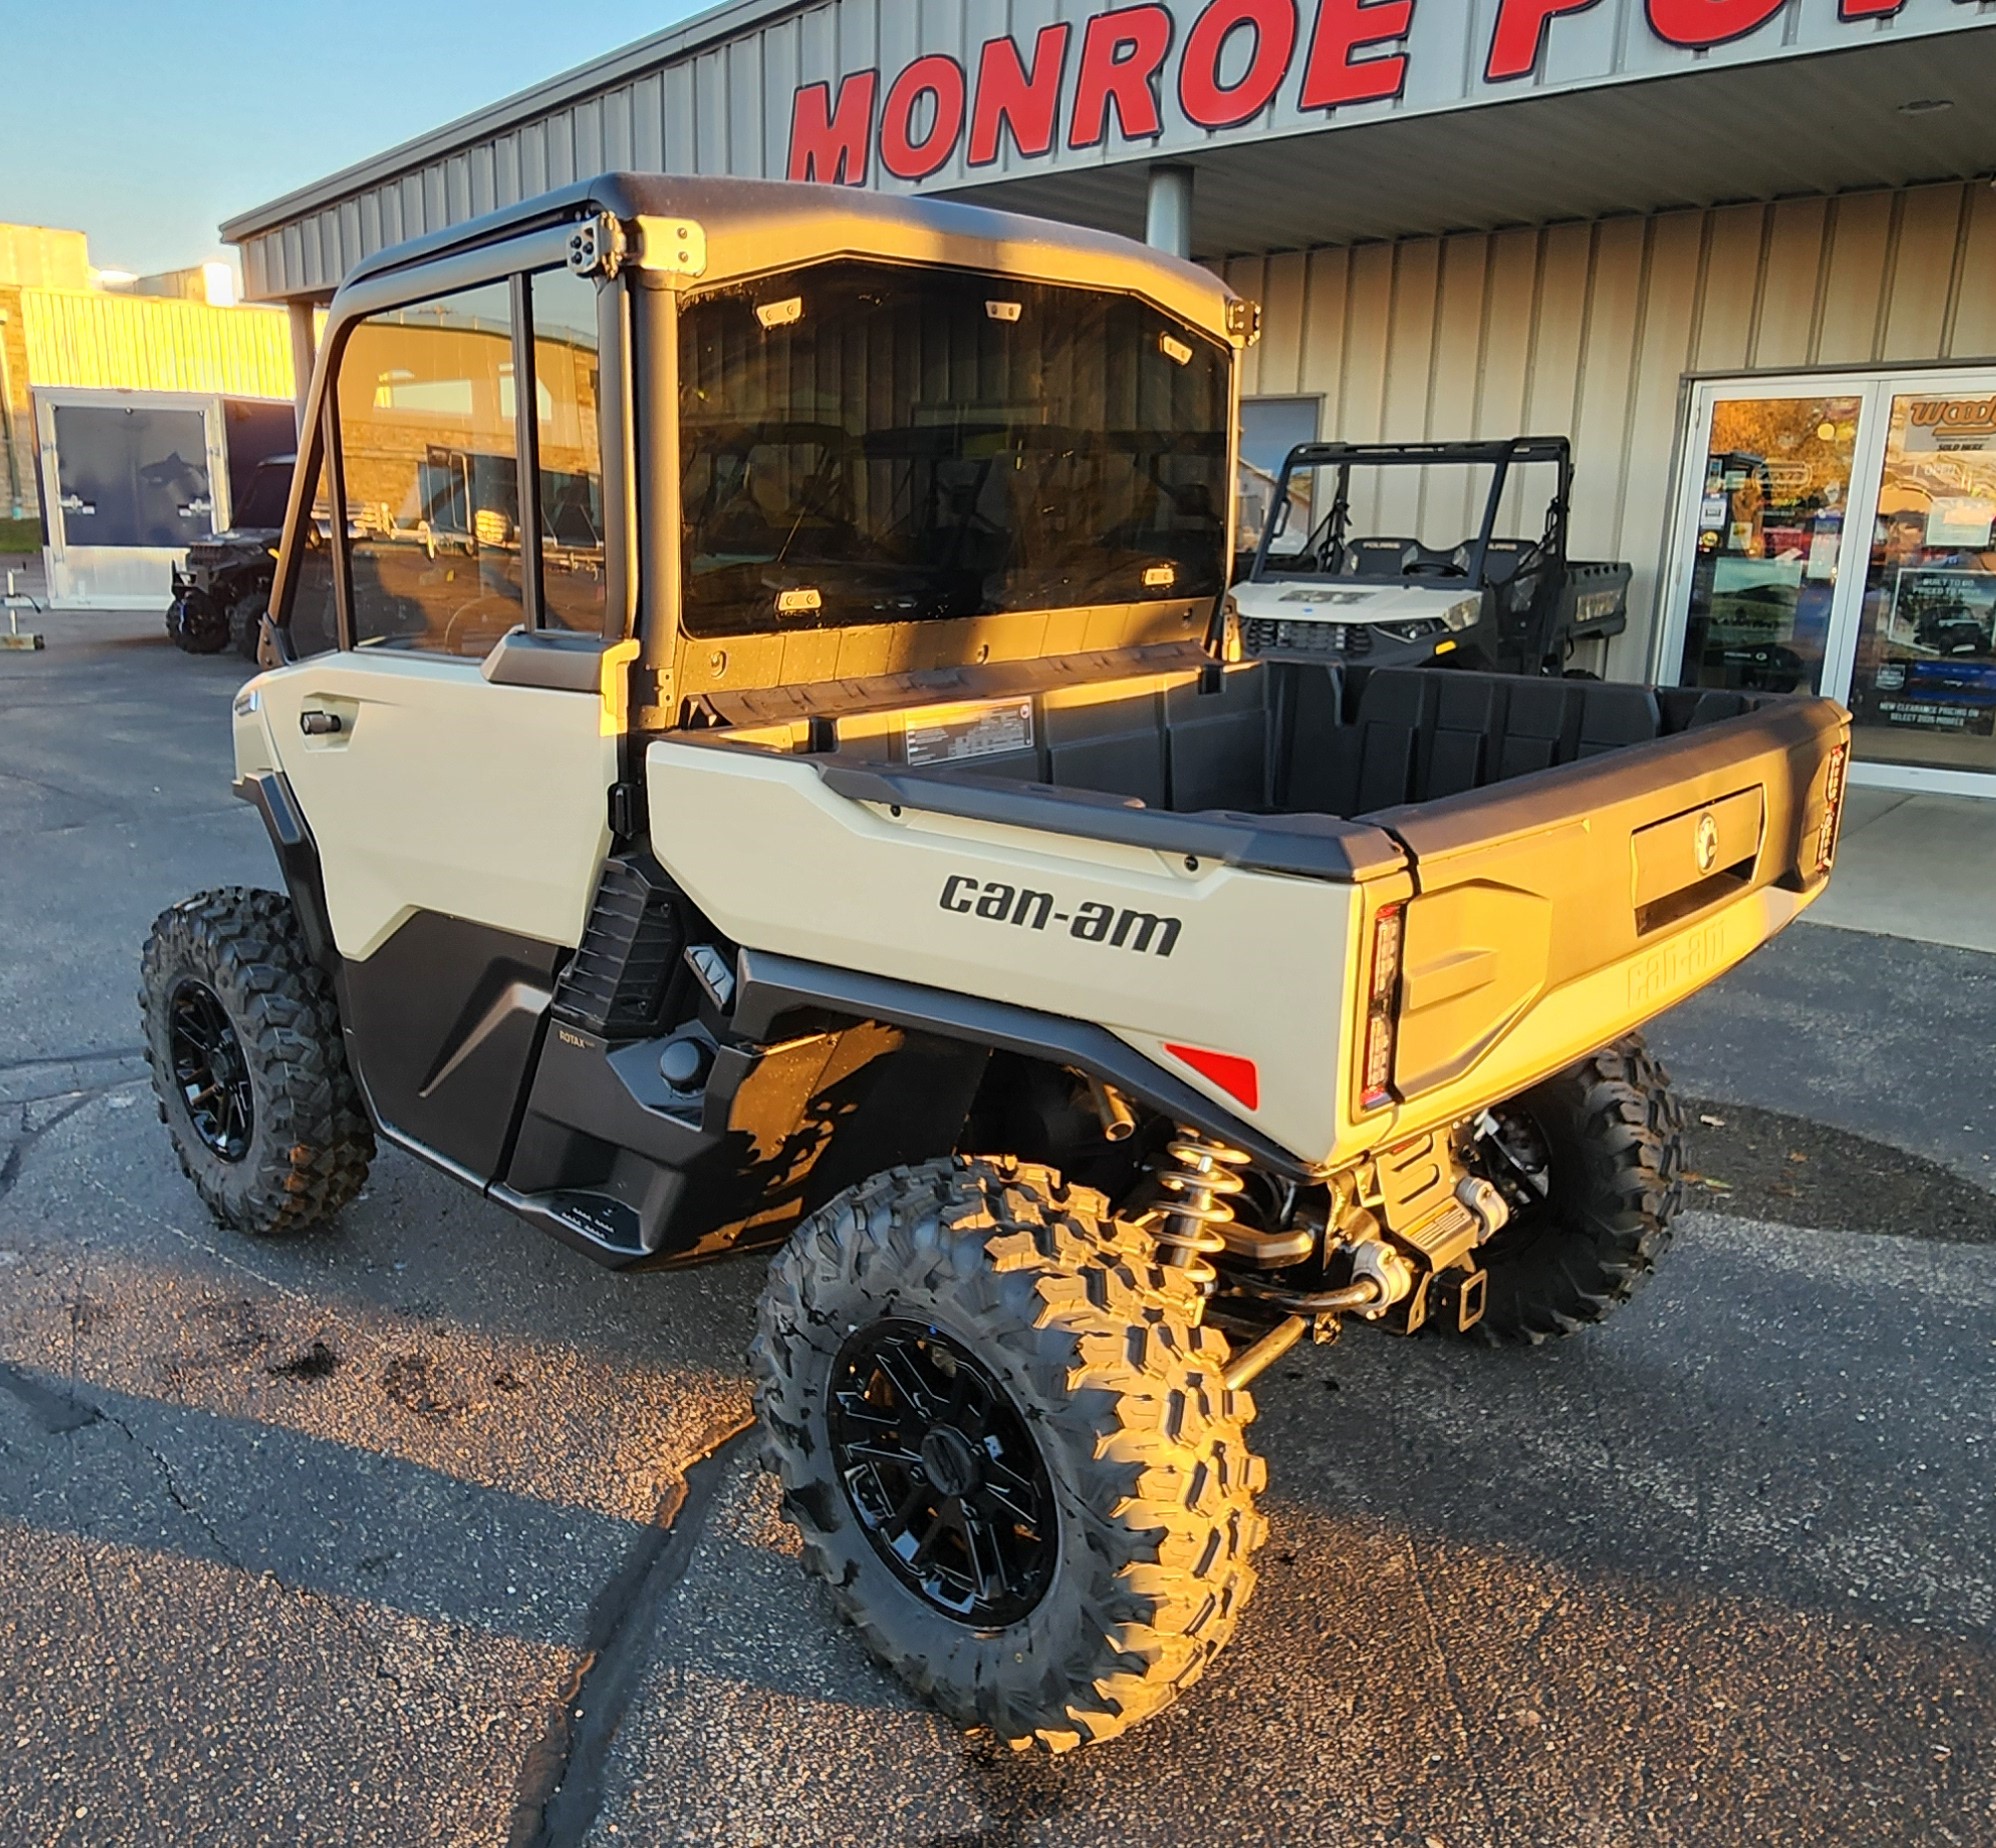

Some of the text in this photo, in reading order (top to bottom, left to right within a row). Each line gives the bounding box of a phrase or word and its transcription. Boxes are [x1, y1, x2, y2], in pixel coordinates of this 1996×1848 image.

[787, 0, 1411, 187] MONROE
[939, 874, 1182, 957] can-am
[559, 1030, 585, 1049] ROTAX
